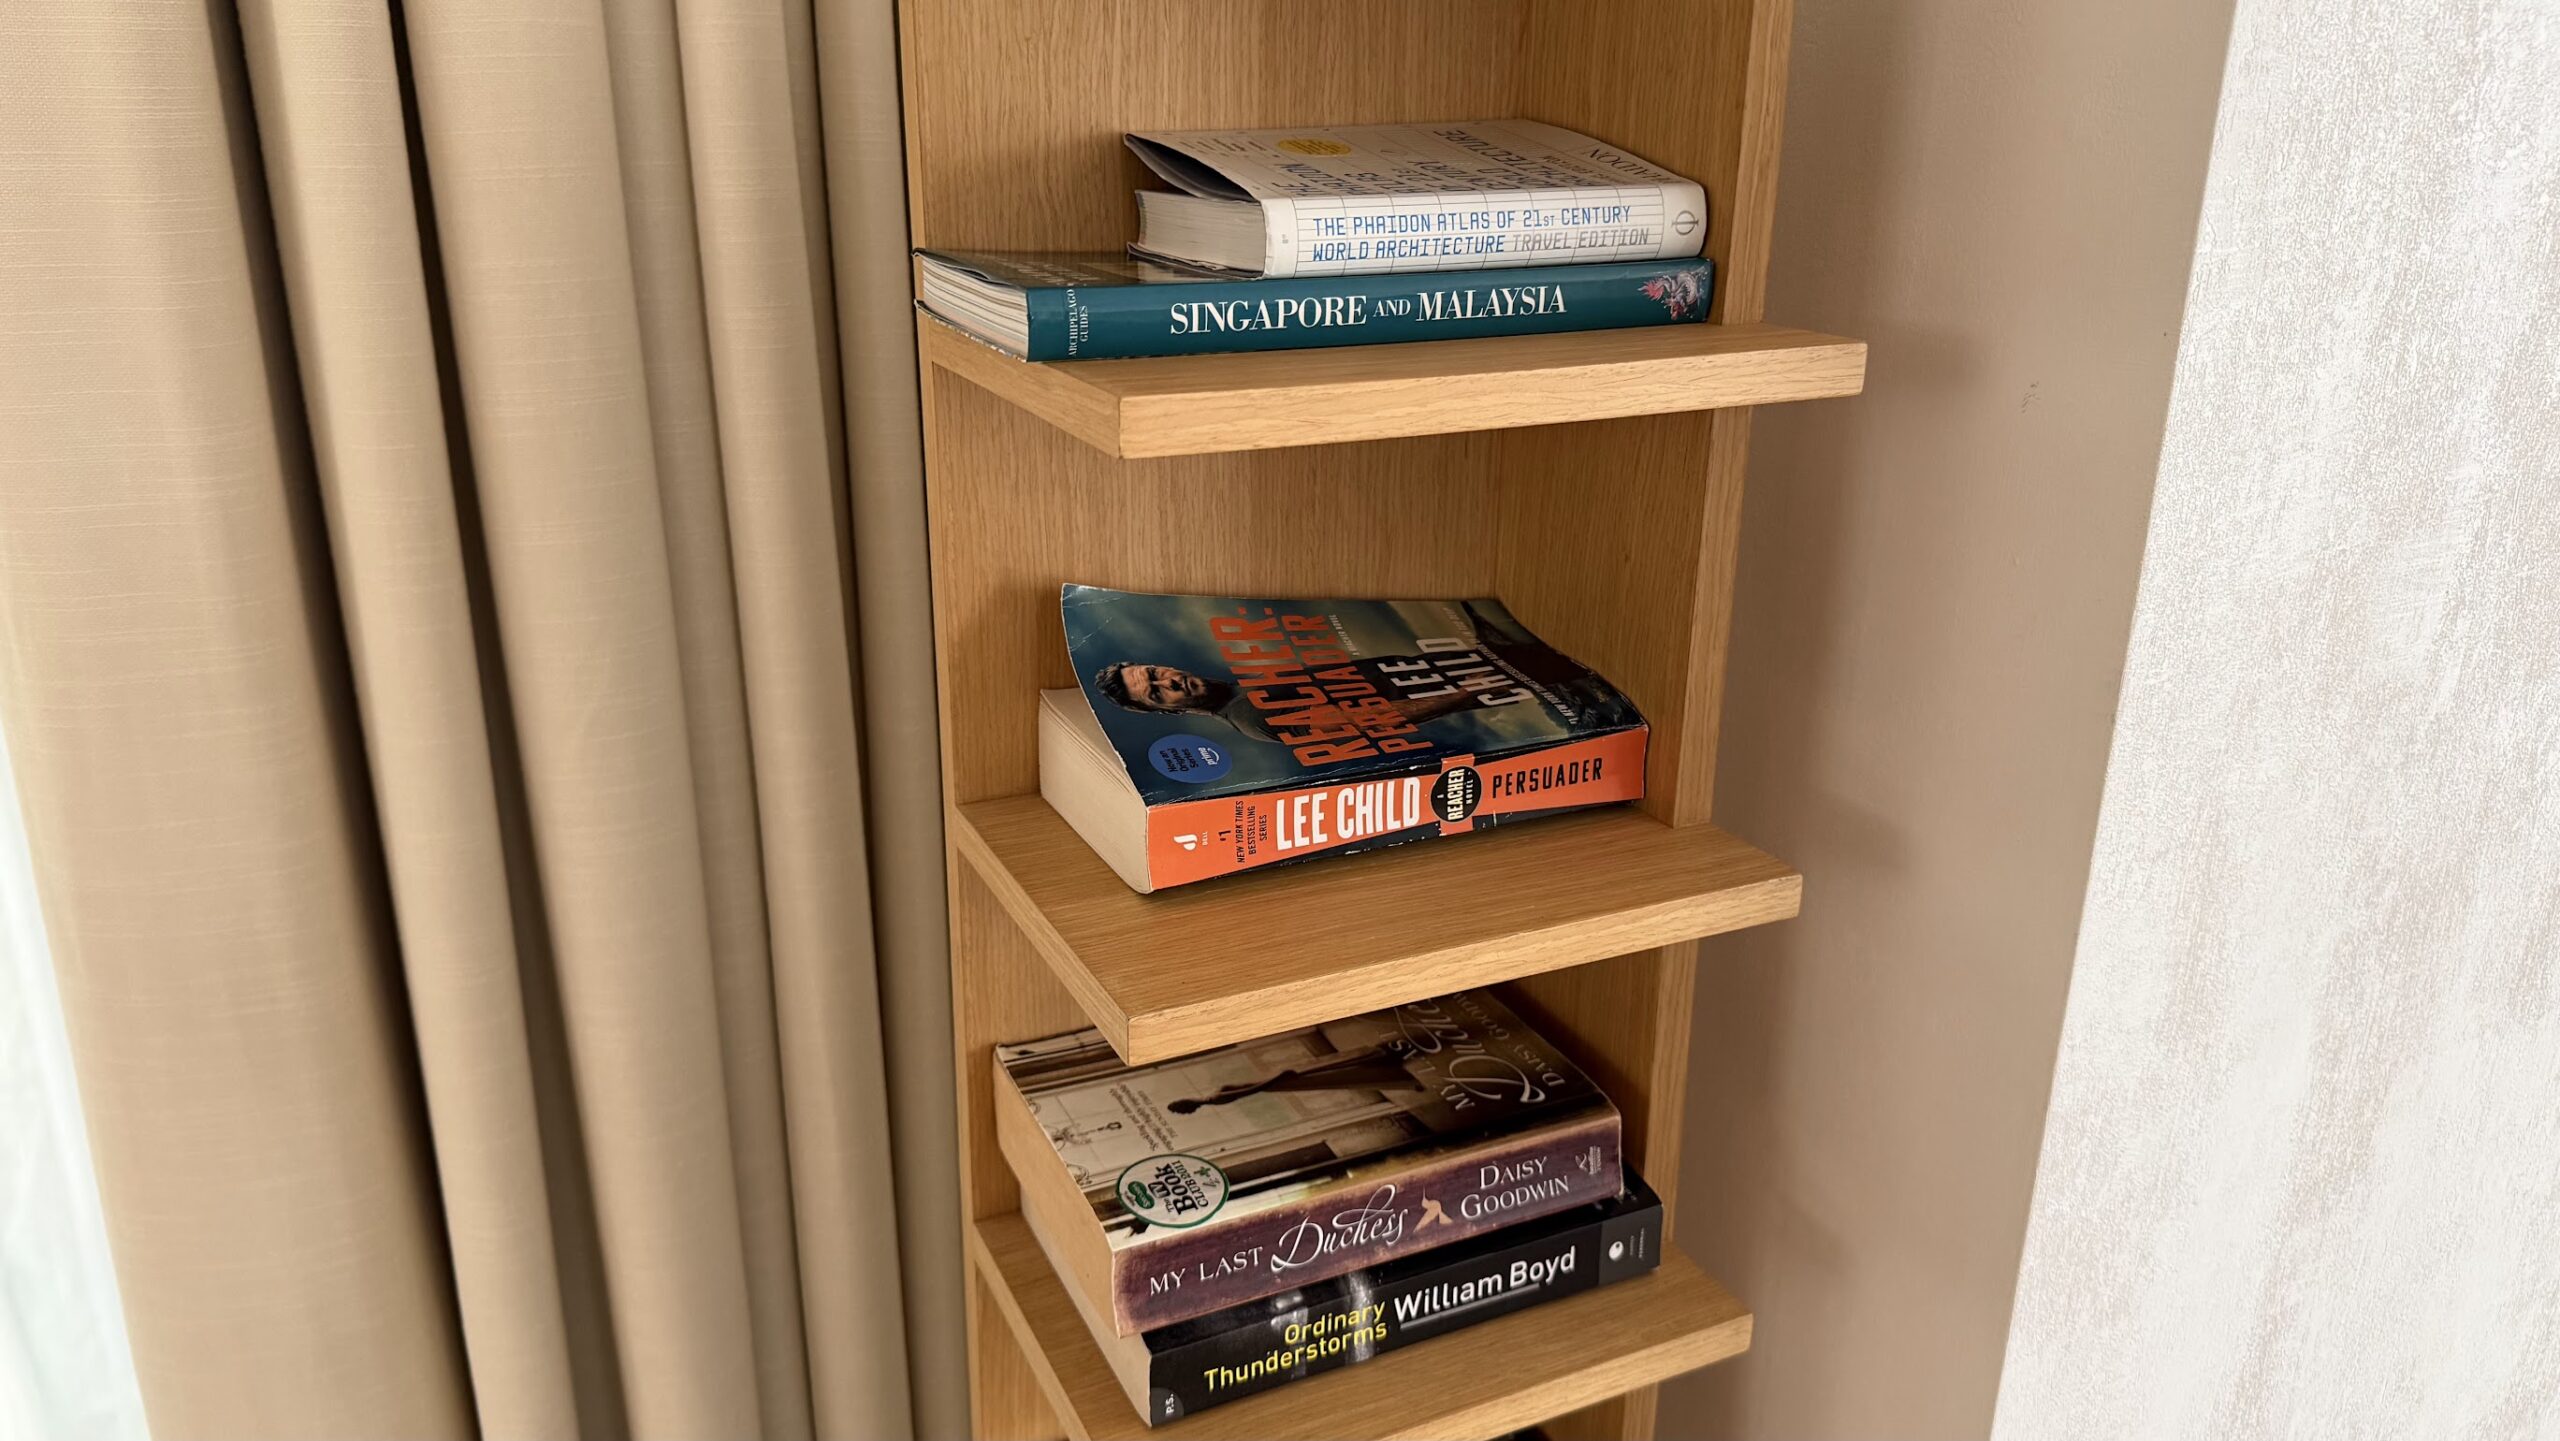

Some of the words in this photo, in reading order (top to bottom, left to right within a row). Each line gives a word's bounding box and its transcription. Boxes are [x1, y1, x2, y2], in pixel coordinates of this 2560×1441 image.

[1313, 217, 1346, 236] THE
[1354, 214, 1430, 236] PHAIDON
[1438, 210, 1490, 232] ATLAS
[1497, 210, 1516, 229] OF
[1561, 206, 1630, 226] CENTURY
[1312, 241, 1368, 262] WORLD
[1376, 235, 1506, 258] ARCHITECTURE
[1512, 232, 1572, 252] TRAVEL
[1578, 228, 1650, 248] EDITION
[1068, 288, 1077, 357] ARCHIPELAGO
[1080, 306, 1089, 342] GUIDES
[1170, 295, 1366, 334] SINGAPORE
[1373, 298, 1411, 318] AND
[1416, 284, 1567, 322] MALAYSIA
[1281, 615, 1434, 754] PERSUADER
[1377, 659, 1460, 700] LEE
[1416, 638, 1535, 706] CHILD
[1198, 746, 1218, 766] prime
[1447, 769, 1465, 820] REACHER
[1466, 779, 1474, 804] NOVEL
[1492, 758, 1603, 798] PERSUADER
[1236, 800, 1244, 822] TIMES
[1259, 814, 1268, 842] SERIES
[1276, 792, 1328, 851] LEE
[1336, 777, 1421, 839] CHILD
[1236, 824, 1244, 844] YORK
[1248, 806, 1256, 855] BESTSELLING
[1237, 846, 1246, 863] NEW
[1440, 1084, 1475, 1110] MY
[1172, 1160, 1191, 1179] 2011
[1480, 1156, 1548, 1190] DAISY
[1155, 1163, 1198, 1215] Book
[1163, 1198, 1176, 1212] The
[1186, 1179, 1209, 1207] CLUB
[1460, 1175, 1570, 1220] GOODWIN
[1150, 1267, 1186, 1297] MY
[1200, 1246, 1264, 1282] LAST
[1271, 1184, 1408, 1273] Duchess
[1394, 1272, 1502, 1323] William
[1510, 1246, 1576, 1290] Boyd
[1284, 1301, 1386, 1345] Ordinary
[1204, 1320, 1388, 1393] Thunderstorms
[1166, 1393, 1175, 1415] P.S.
